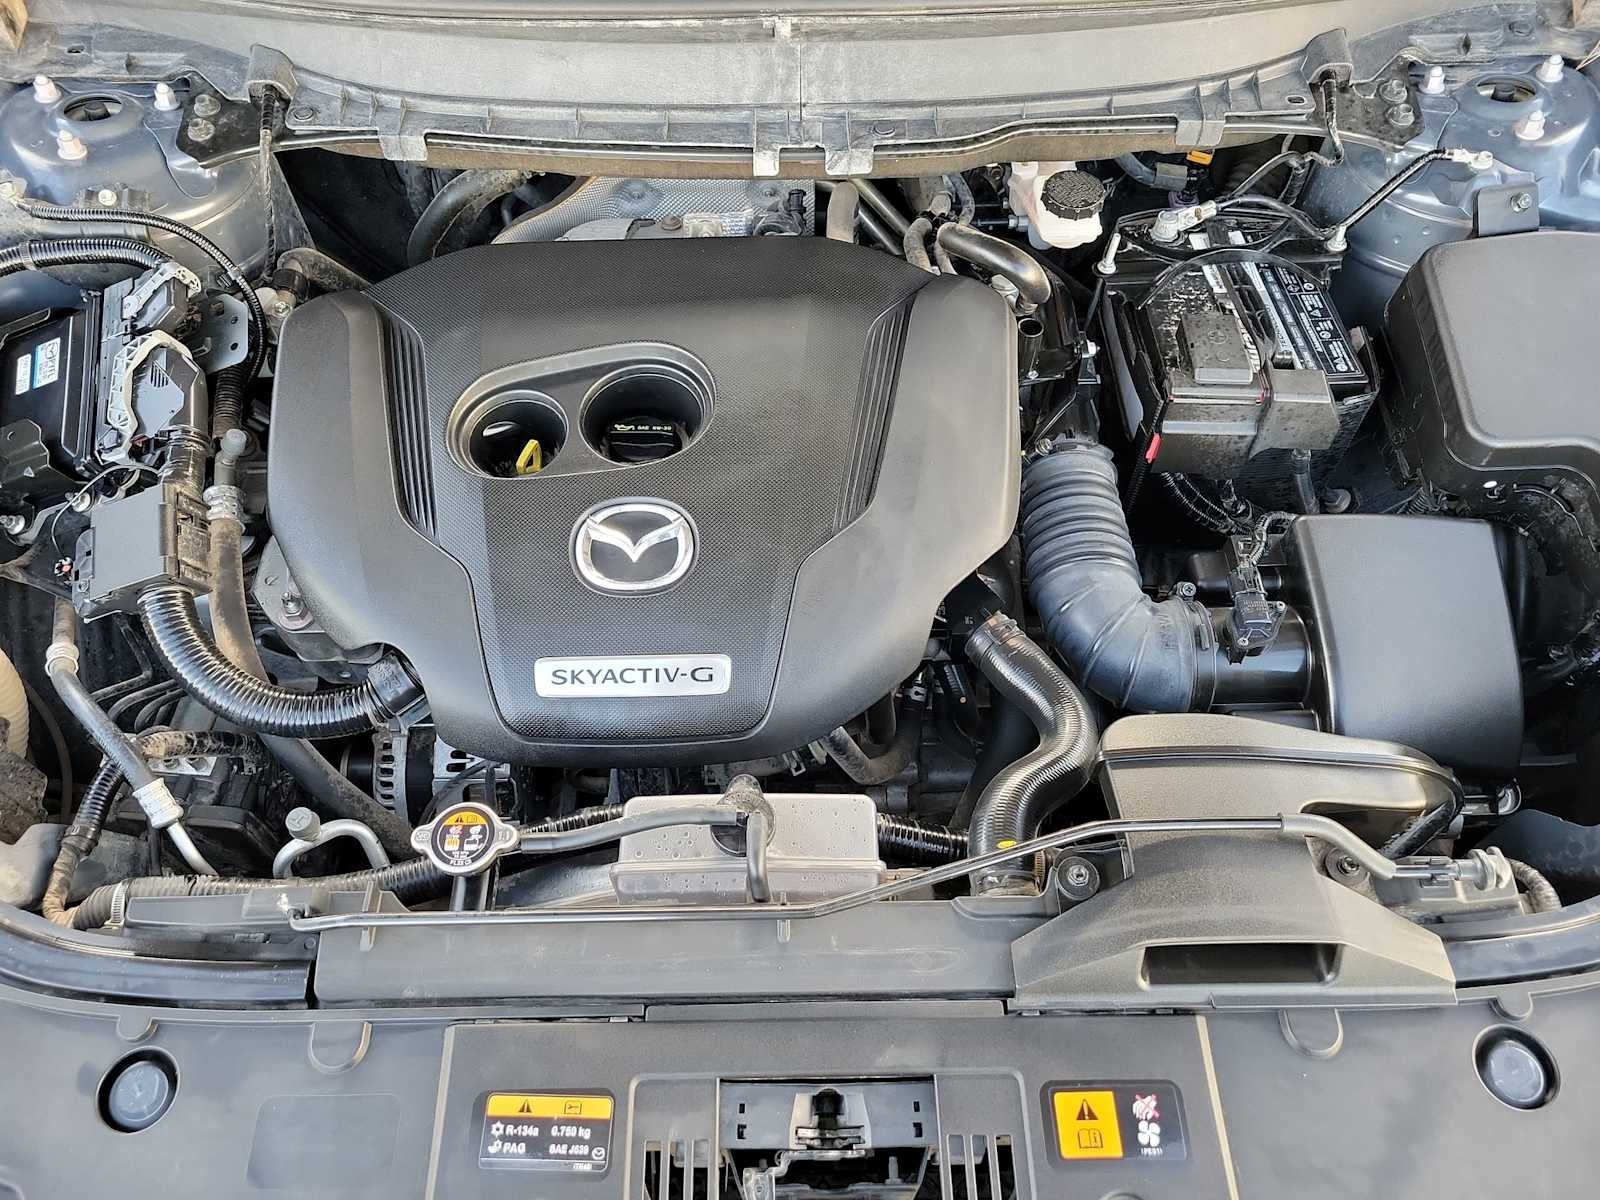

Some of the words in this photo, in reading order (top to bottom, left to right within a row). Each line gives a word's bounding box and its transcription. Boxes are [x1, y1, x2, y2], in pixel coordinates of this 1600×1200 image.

[551, 667, 714, 685] SKYACTIV-G
[505, 1124, 539, 1137] R-134a
[578, 1125, 591, 1139] kg
[502, 1142, 526, 1154] PAG
